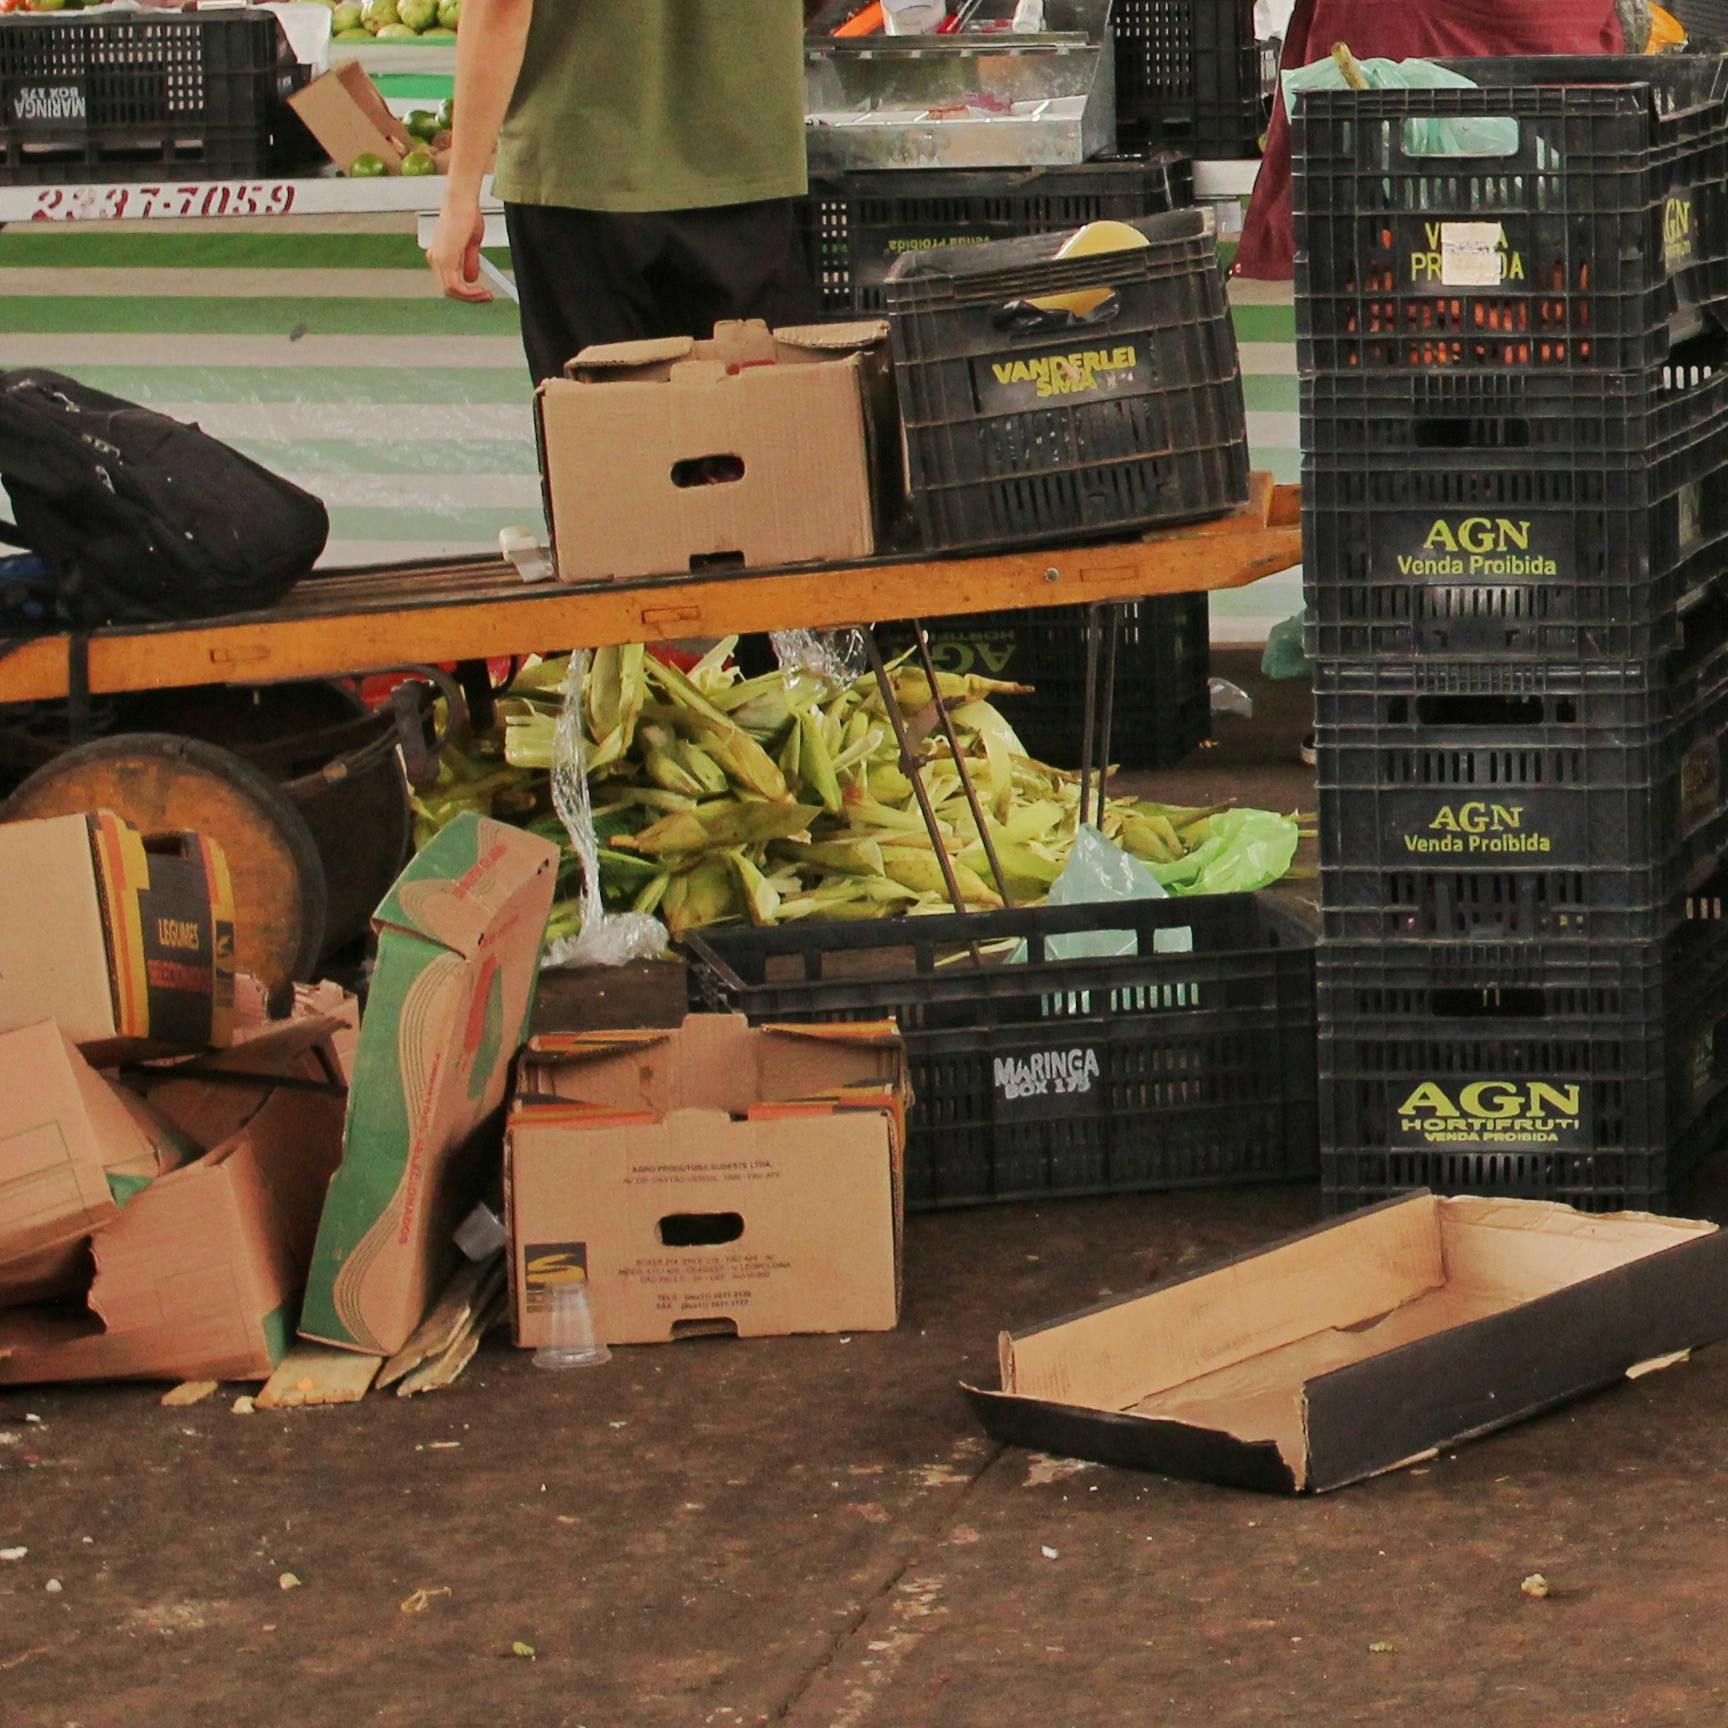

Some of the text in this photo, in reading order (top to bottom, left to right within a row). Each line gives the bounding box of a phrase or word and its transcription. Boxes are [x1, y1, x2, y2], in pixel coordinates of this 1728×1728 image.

[992, 345, 1137, 385] VANDERLEI
[1421, 516, 1531, 553] AGN
[1397, 553, 1558, 577] Venda Proibida
[1428, 800, 1524, 833] AGN
[1404, 831, 1551, 855] Venda Proibida
[1397, 1080, 1582, 1119] AGN
[1400, 1118, 1581, 1133] HORTIFRUTI
